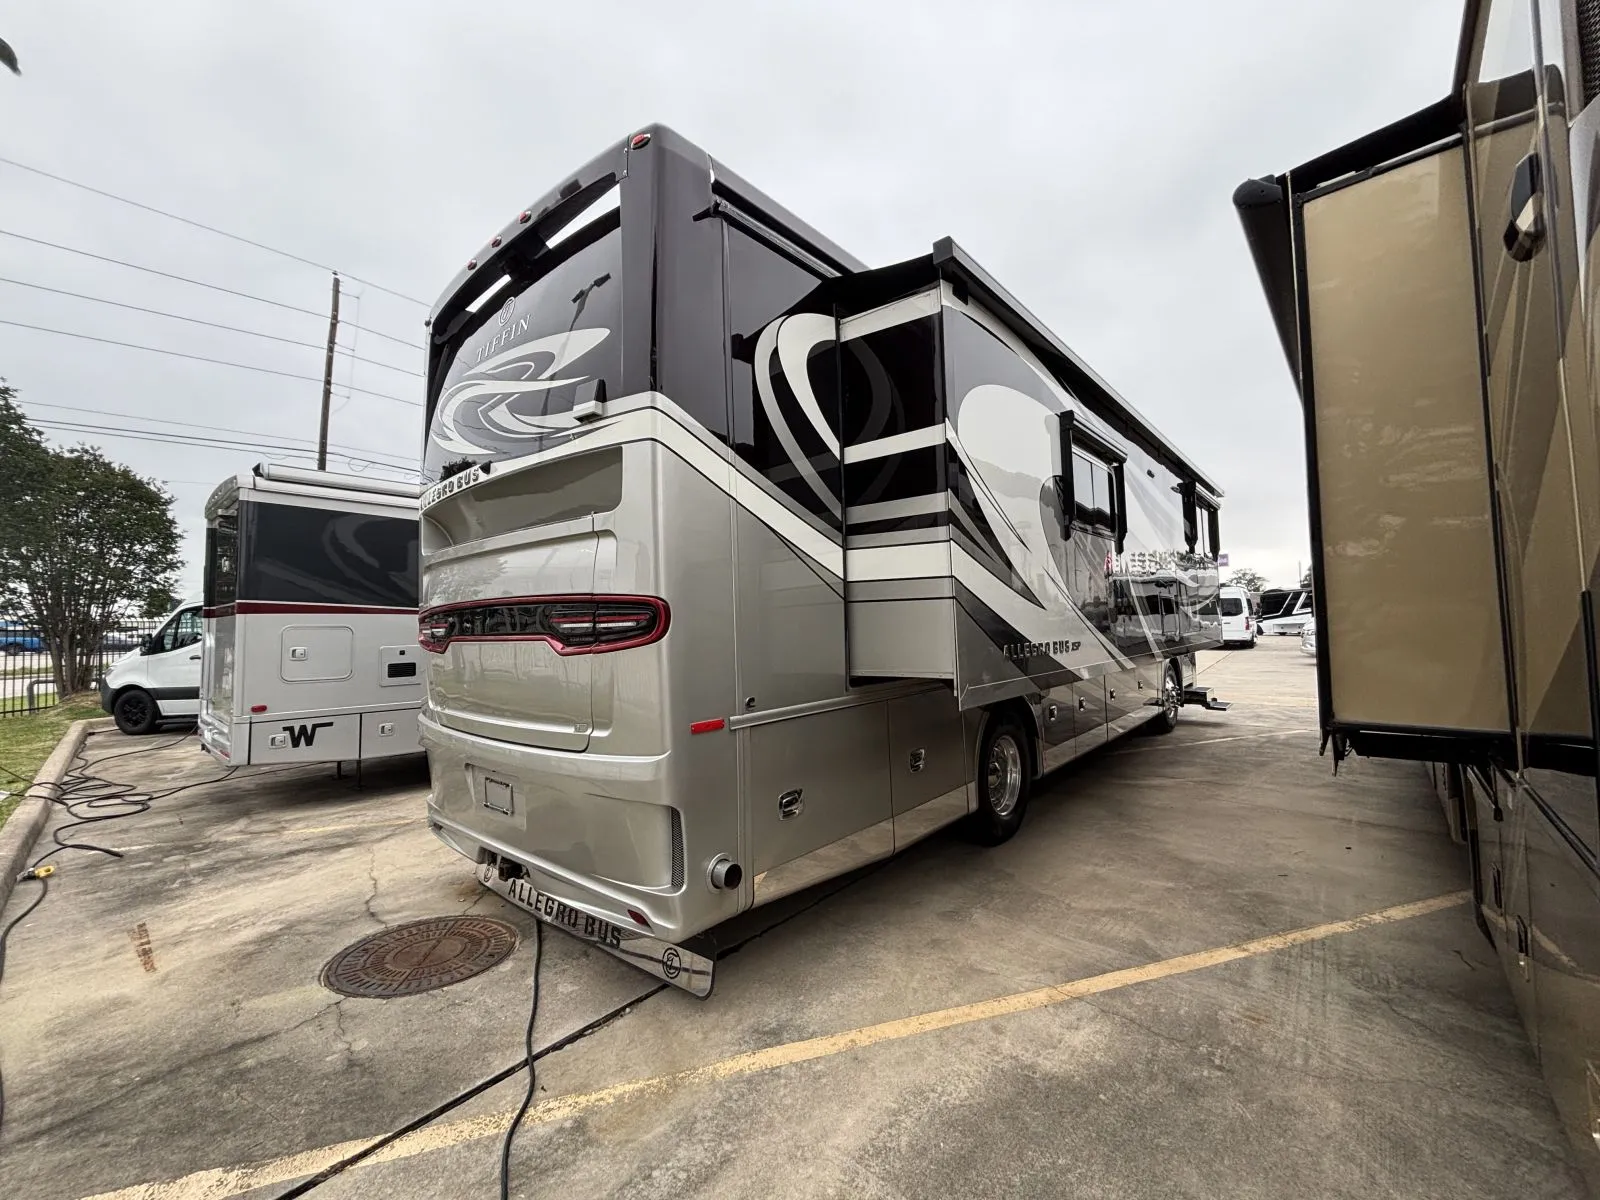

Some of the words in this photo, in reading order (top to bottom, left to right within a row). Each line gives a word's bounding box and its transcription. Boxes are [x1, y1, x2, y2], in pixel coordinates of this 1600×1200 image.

[476, 313, 531, 363] TIFFIN
[456, 467, 480, 490] BUS
[1003, 641, 1051, 660] ALLEGRO
[1052, 639, 1070, 655] BUS
[508, 879, 579, 929] ALLEGRO
[584, 914, 621, 950] BUS
